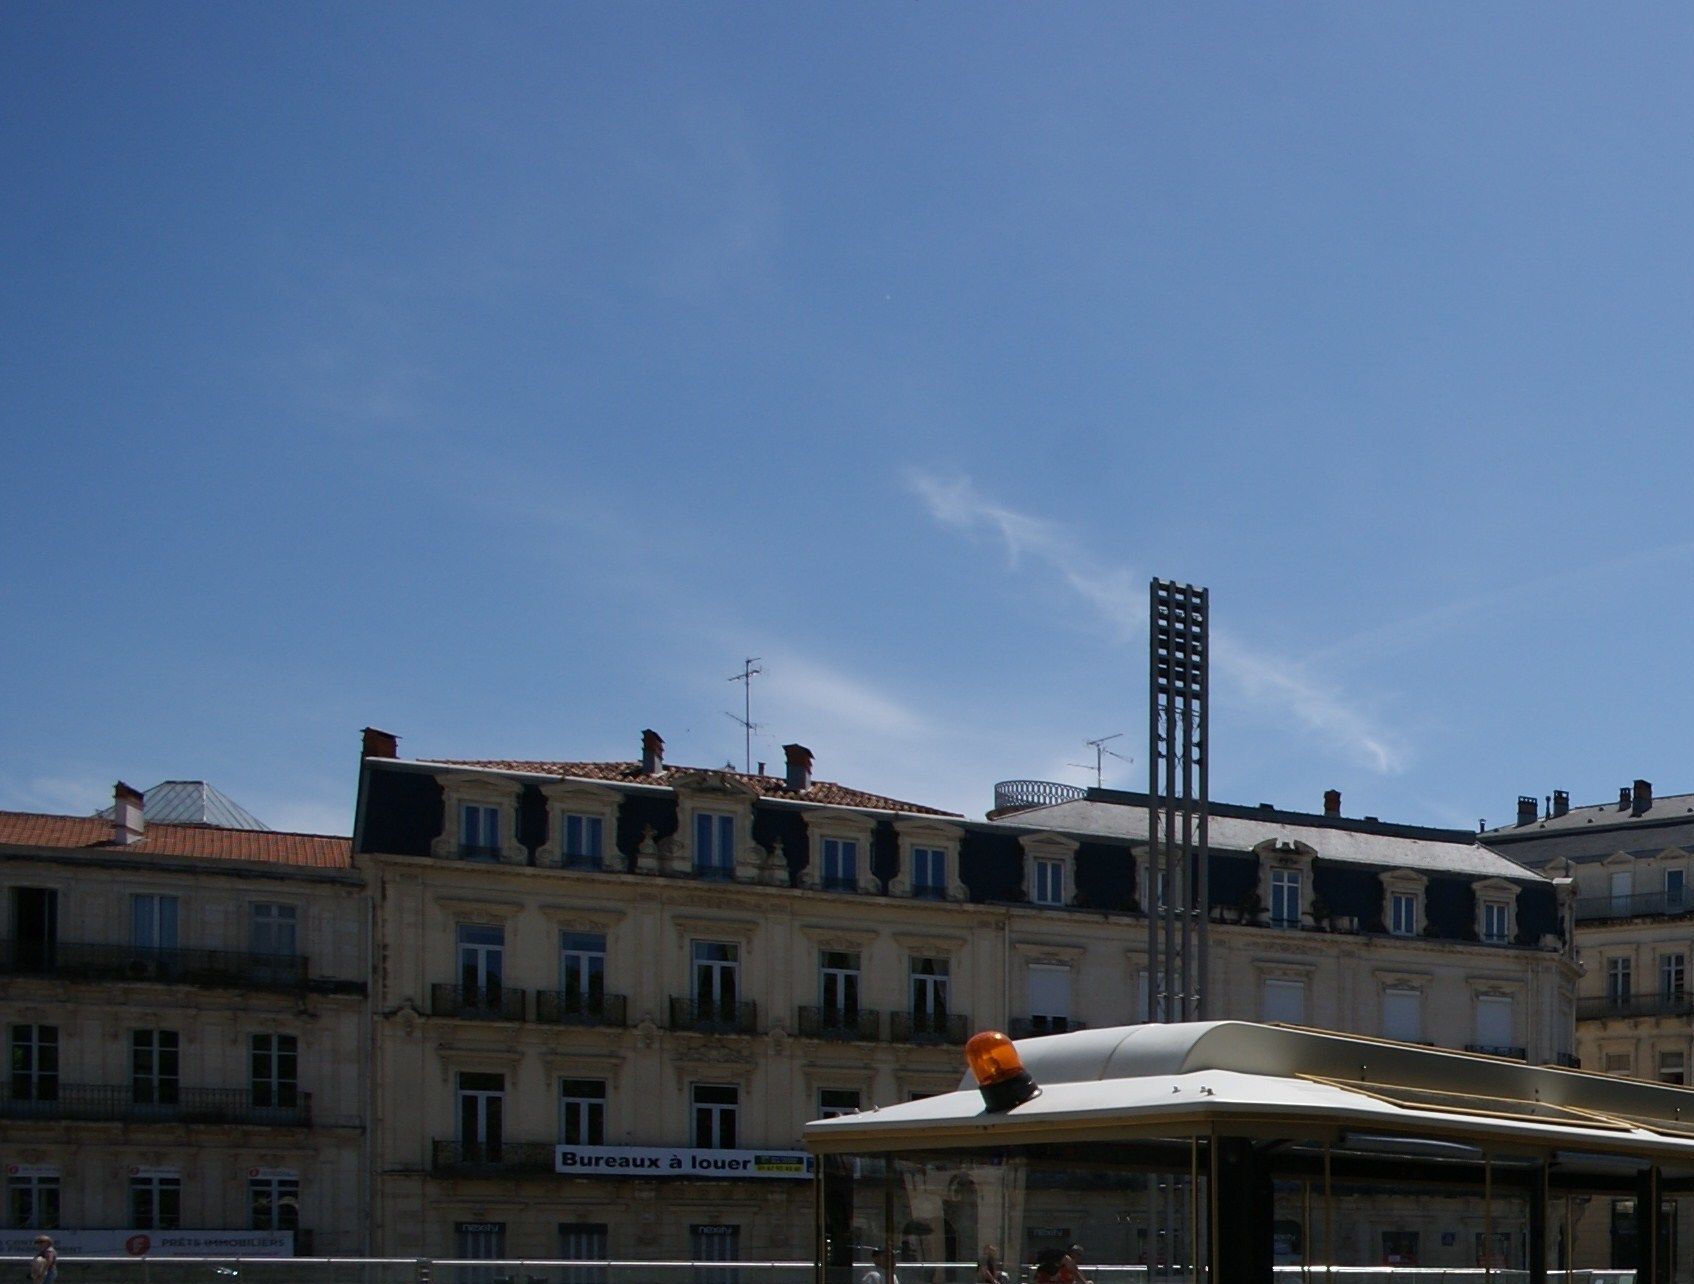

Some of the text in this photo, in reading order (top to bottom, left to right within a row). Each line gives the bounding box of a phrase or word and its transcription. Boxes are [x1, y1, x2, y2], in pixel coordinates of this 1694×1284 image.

[562, 1151, 660, 1169] Bureaux
[669, 1154, 682, 1169] à
[692, 1155, 752, 1171] louer
